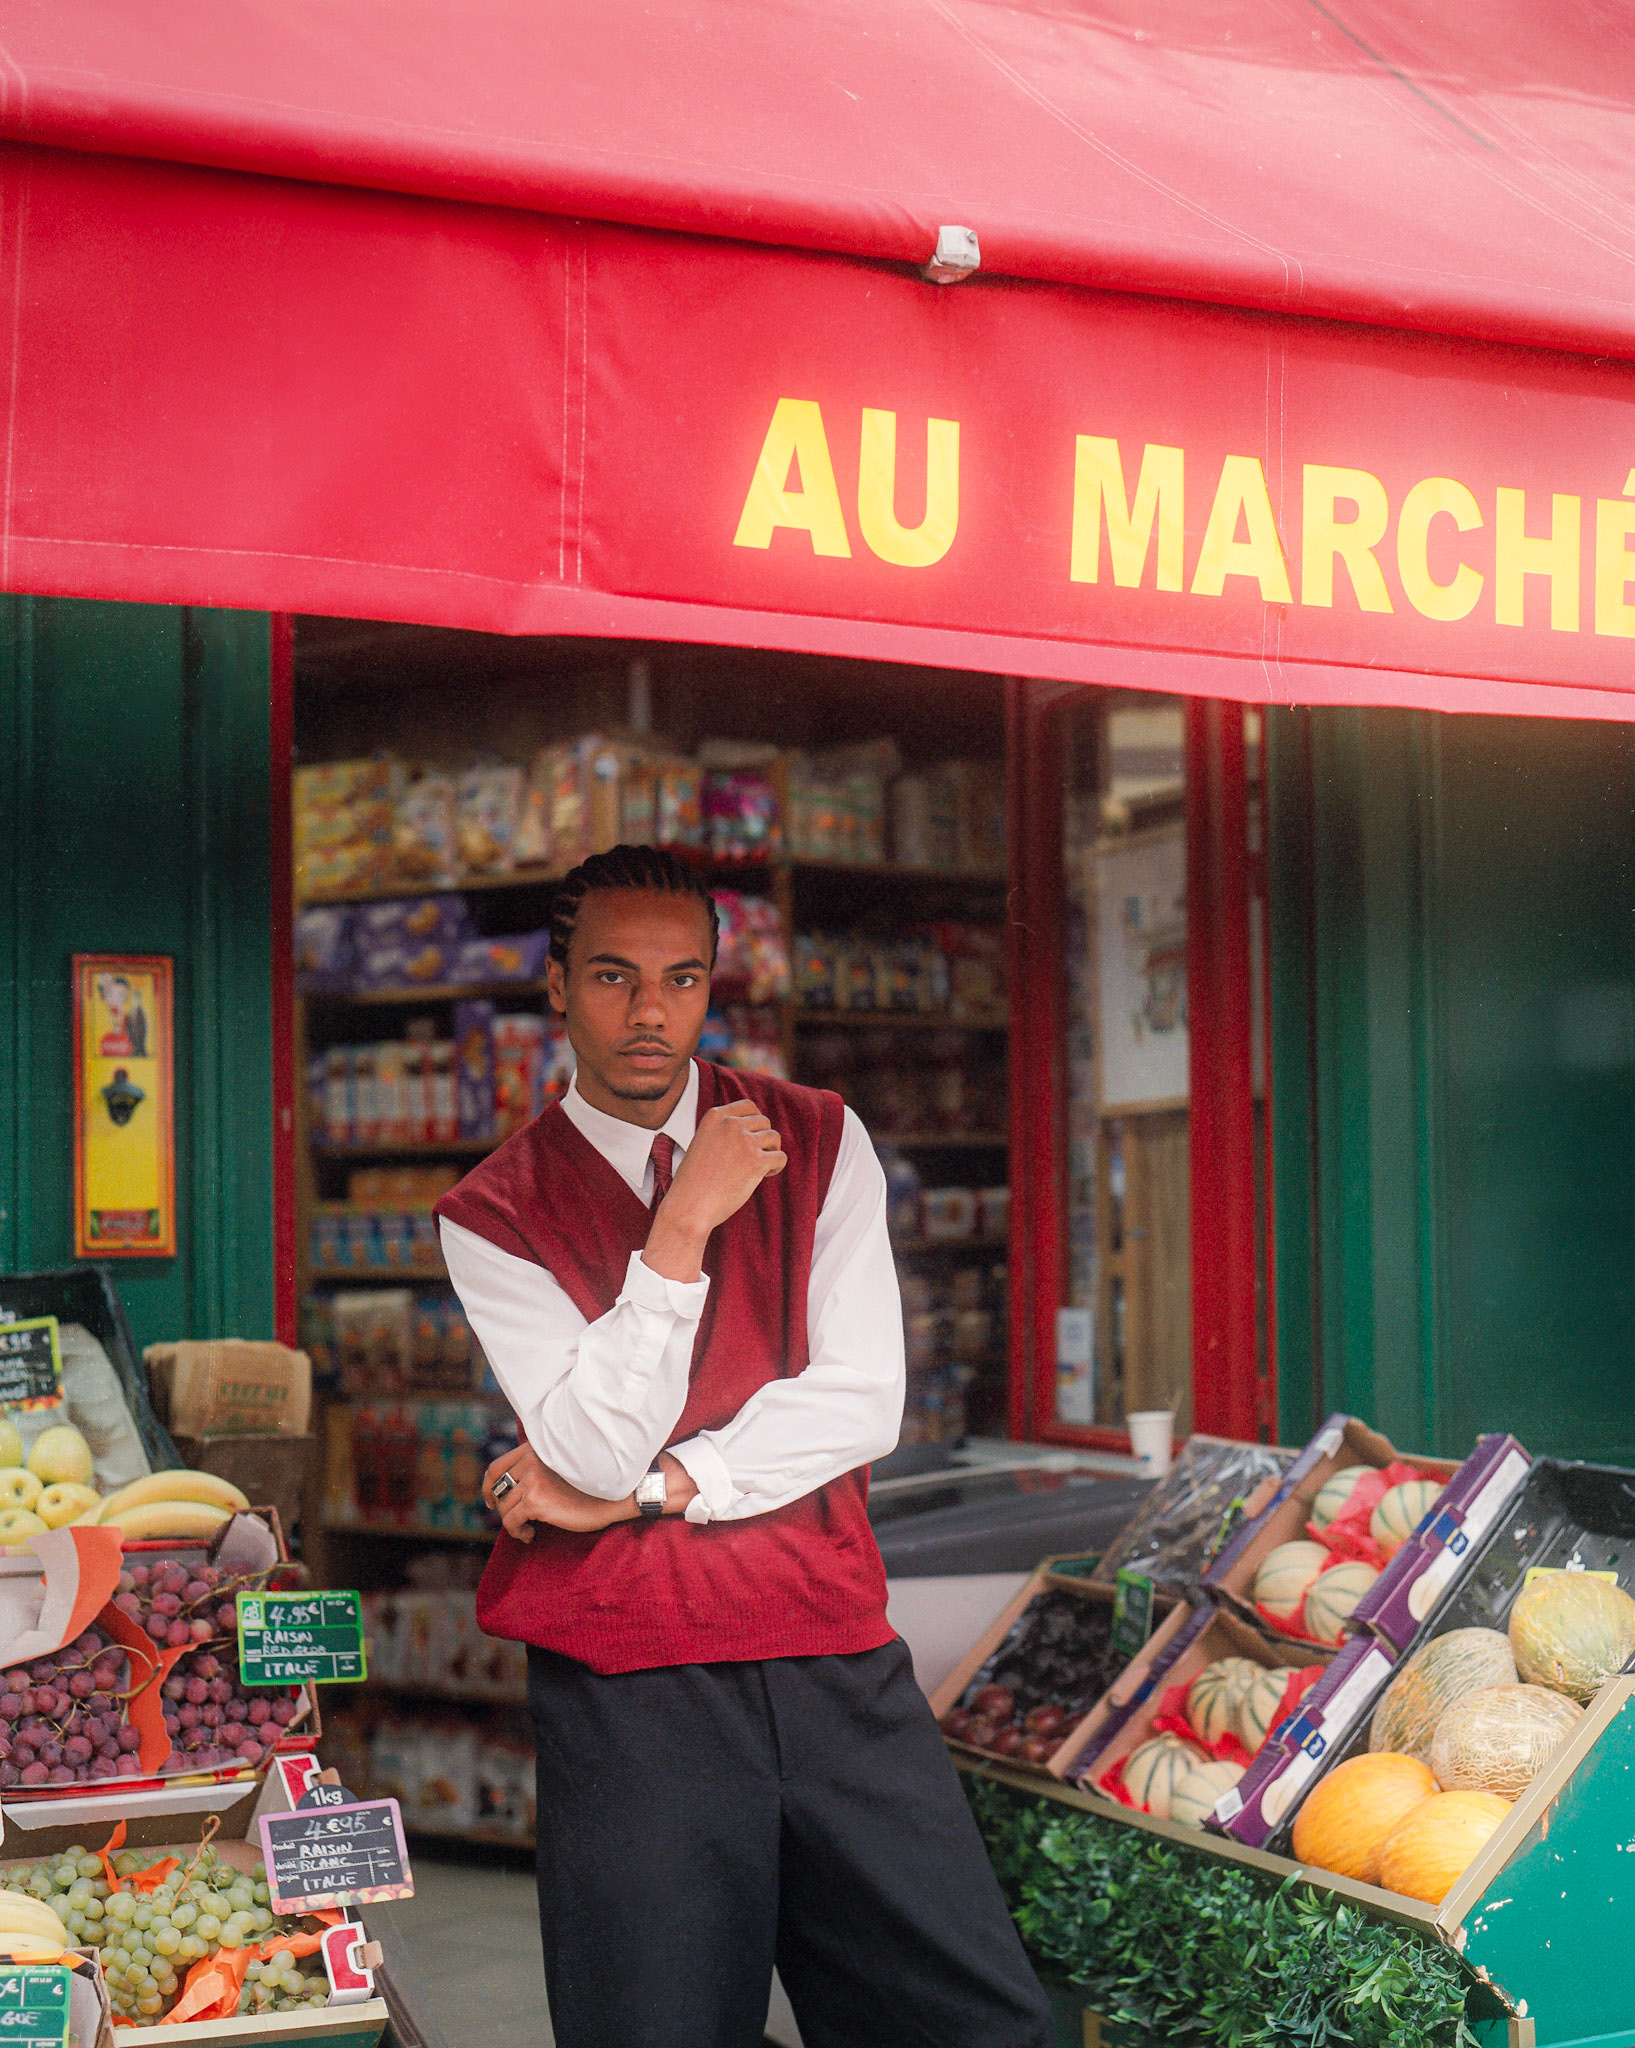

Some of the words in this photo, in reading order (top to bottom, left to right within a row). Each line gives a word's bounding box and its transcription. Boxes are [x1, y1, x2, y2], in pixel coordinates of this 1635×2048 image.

[733, 397, 960, 568] AU
[262, 1630, 313, 1645] RAISIN
[264, 1660, 321, 1678] ITALIE
[310, 1786, 344, 1806] 1kg
[300, 1841, 353, 1859] RAISIN
[300, 1857, 352, 1871] BLANC
[303, 1871, 359, 1891] ITALIE
